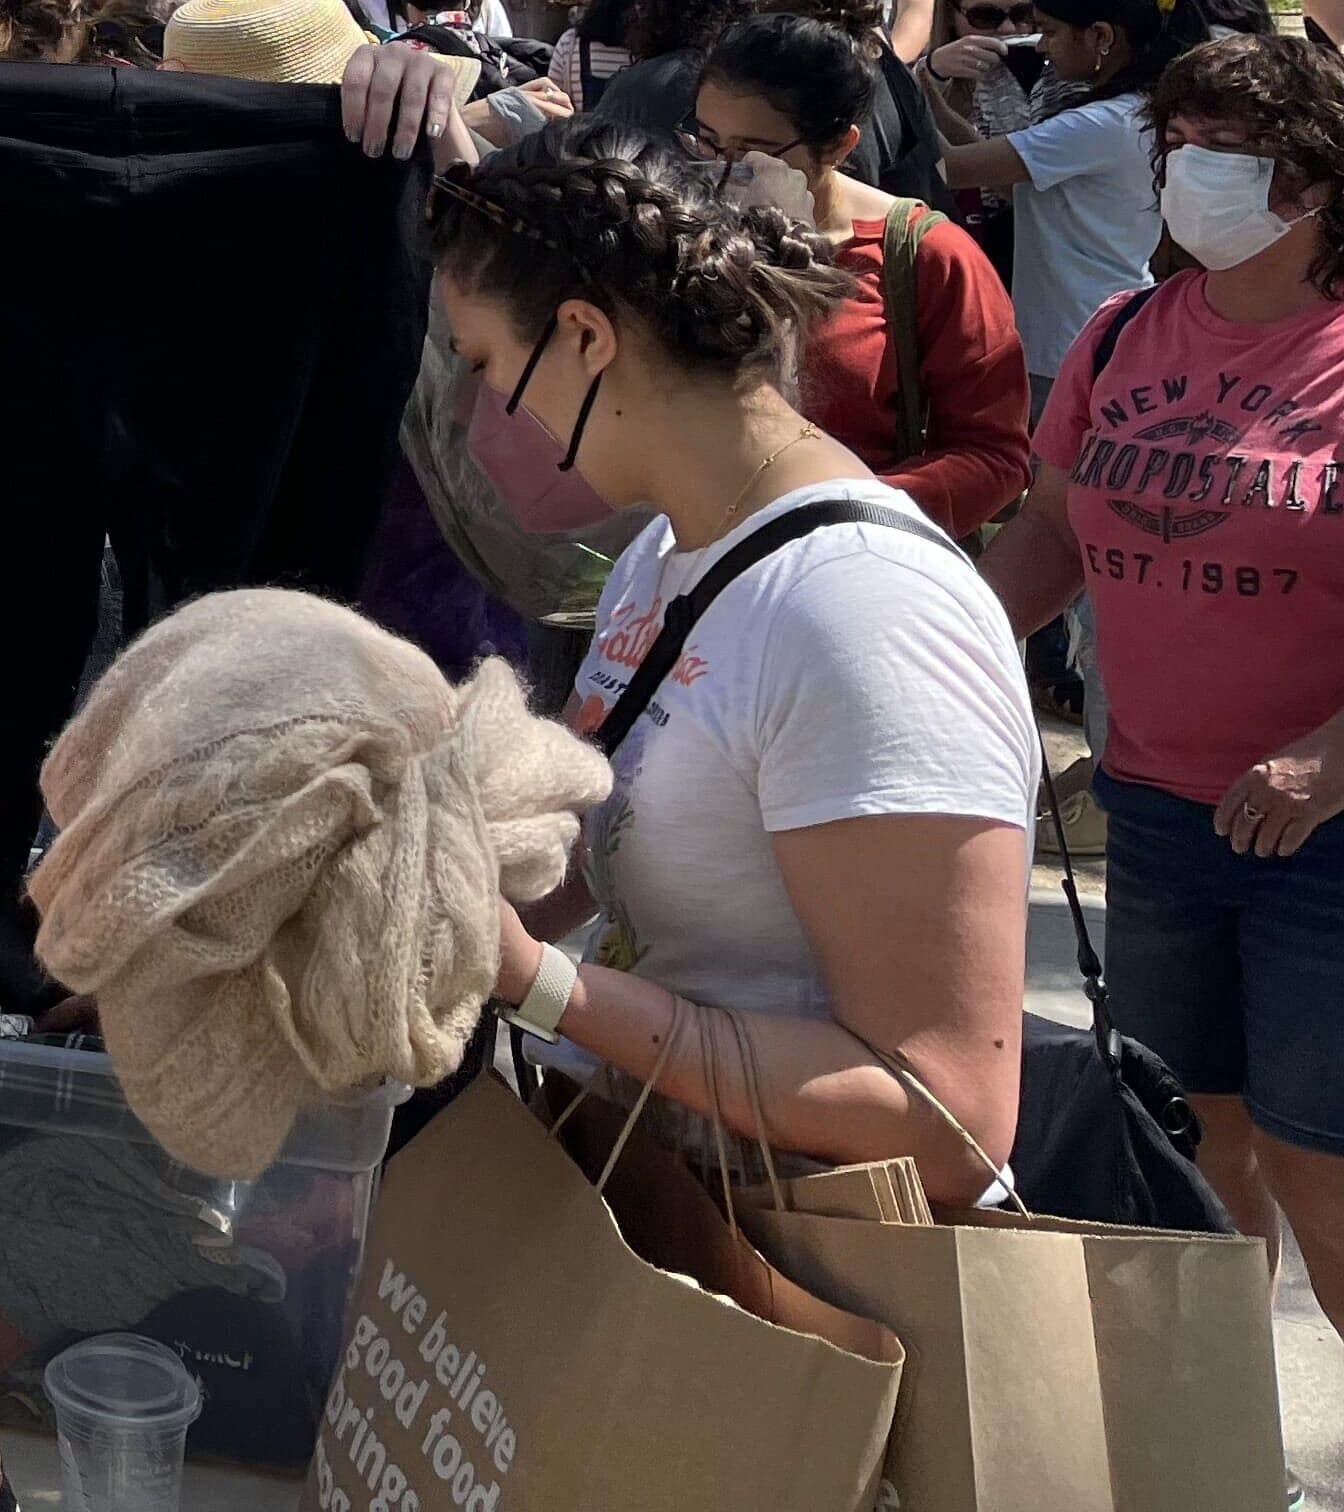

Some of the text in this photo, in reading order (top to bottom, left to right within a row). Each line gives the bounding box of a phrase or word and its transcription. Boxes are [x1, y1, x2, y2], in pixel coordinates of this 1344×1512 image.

[1100, 374, 1188, 429] NEW
[1217, 372, 1323, 444] YORK
[1085, 543, 1299, 597] EST. 1987
[346, 1314, 430, 1430] good
[378, 1258, 517, 1474] we believe
